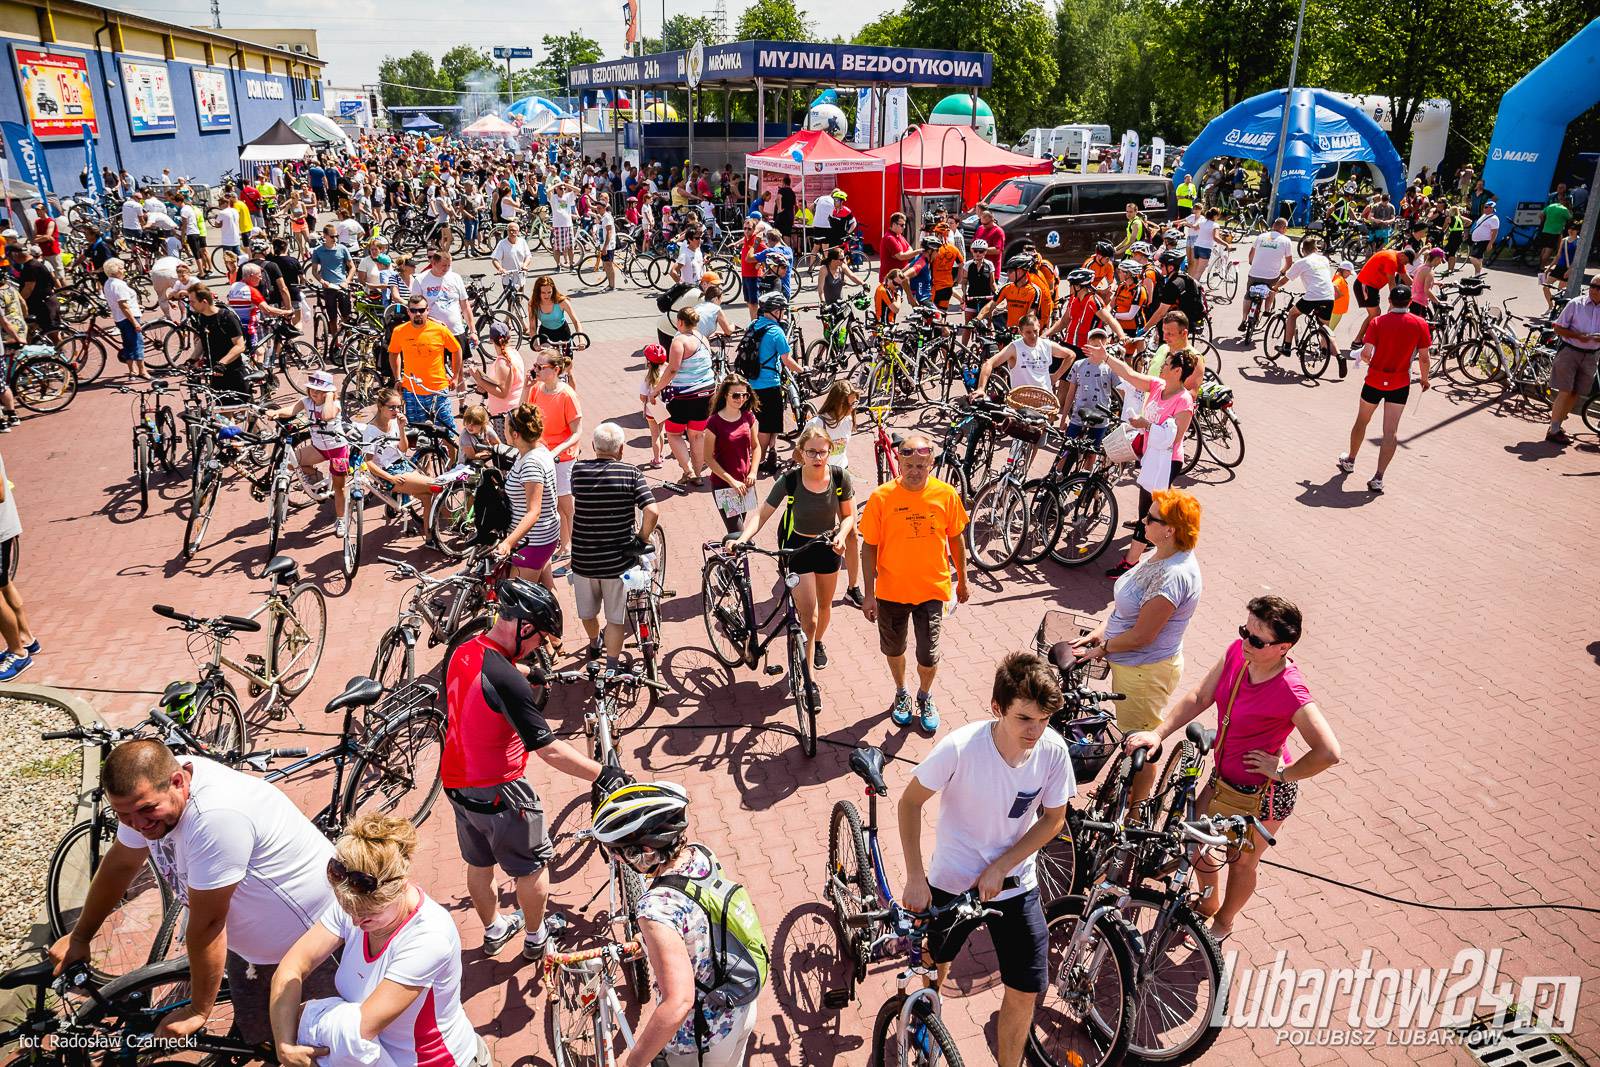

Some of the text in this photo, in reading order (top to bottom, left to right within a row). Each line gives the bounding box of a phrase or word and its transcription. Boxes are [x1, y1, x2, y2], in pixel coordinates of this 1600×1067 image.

[708, 51, 742, 72] MRÓWKA
[759, 50, 983, 78] MYJNIA BEZDOTYKOWA
[592, 62, 640, 84] BEZDOTYKOWA
[644, 60, 660, 80] 24h
[1239, 132, 1276, 146] MAPEI
[1331, 134, 1361, 149] MAPEI
[1502, 150, 1540, 163] MAPEI
